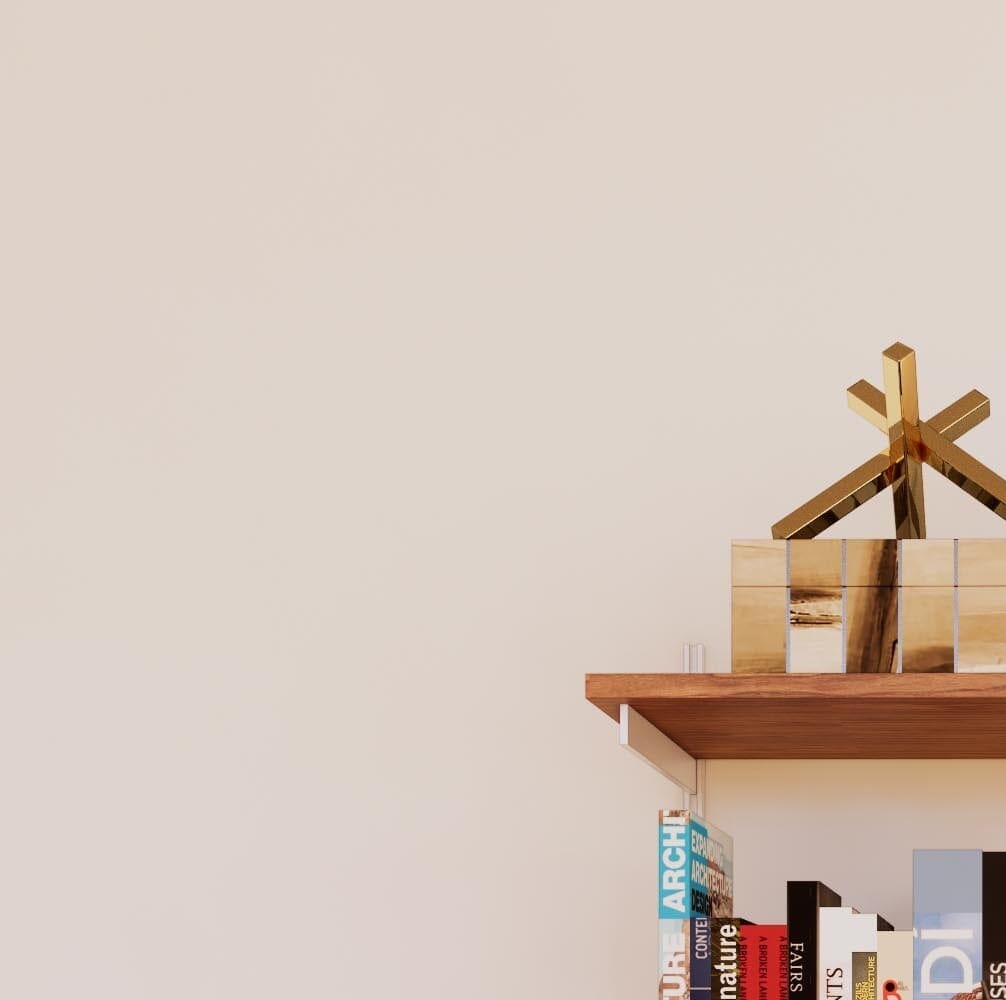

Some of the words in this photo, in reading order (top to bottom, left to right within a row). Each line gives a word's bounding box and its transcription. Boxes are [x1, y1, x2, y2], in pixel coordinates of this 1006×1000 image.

[695, 917, 707, 959] CONTE
[758, 944, 767, 979] BROKEN
[790, 942, 804, 992] FAIRS
